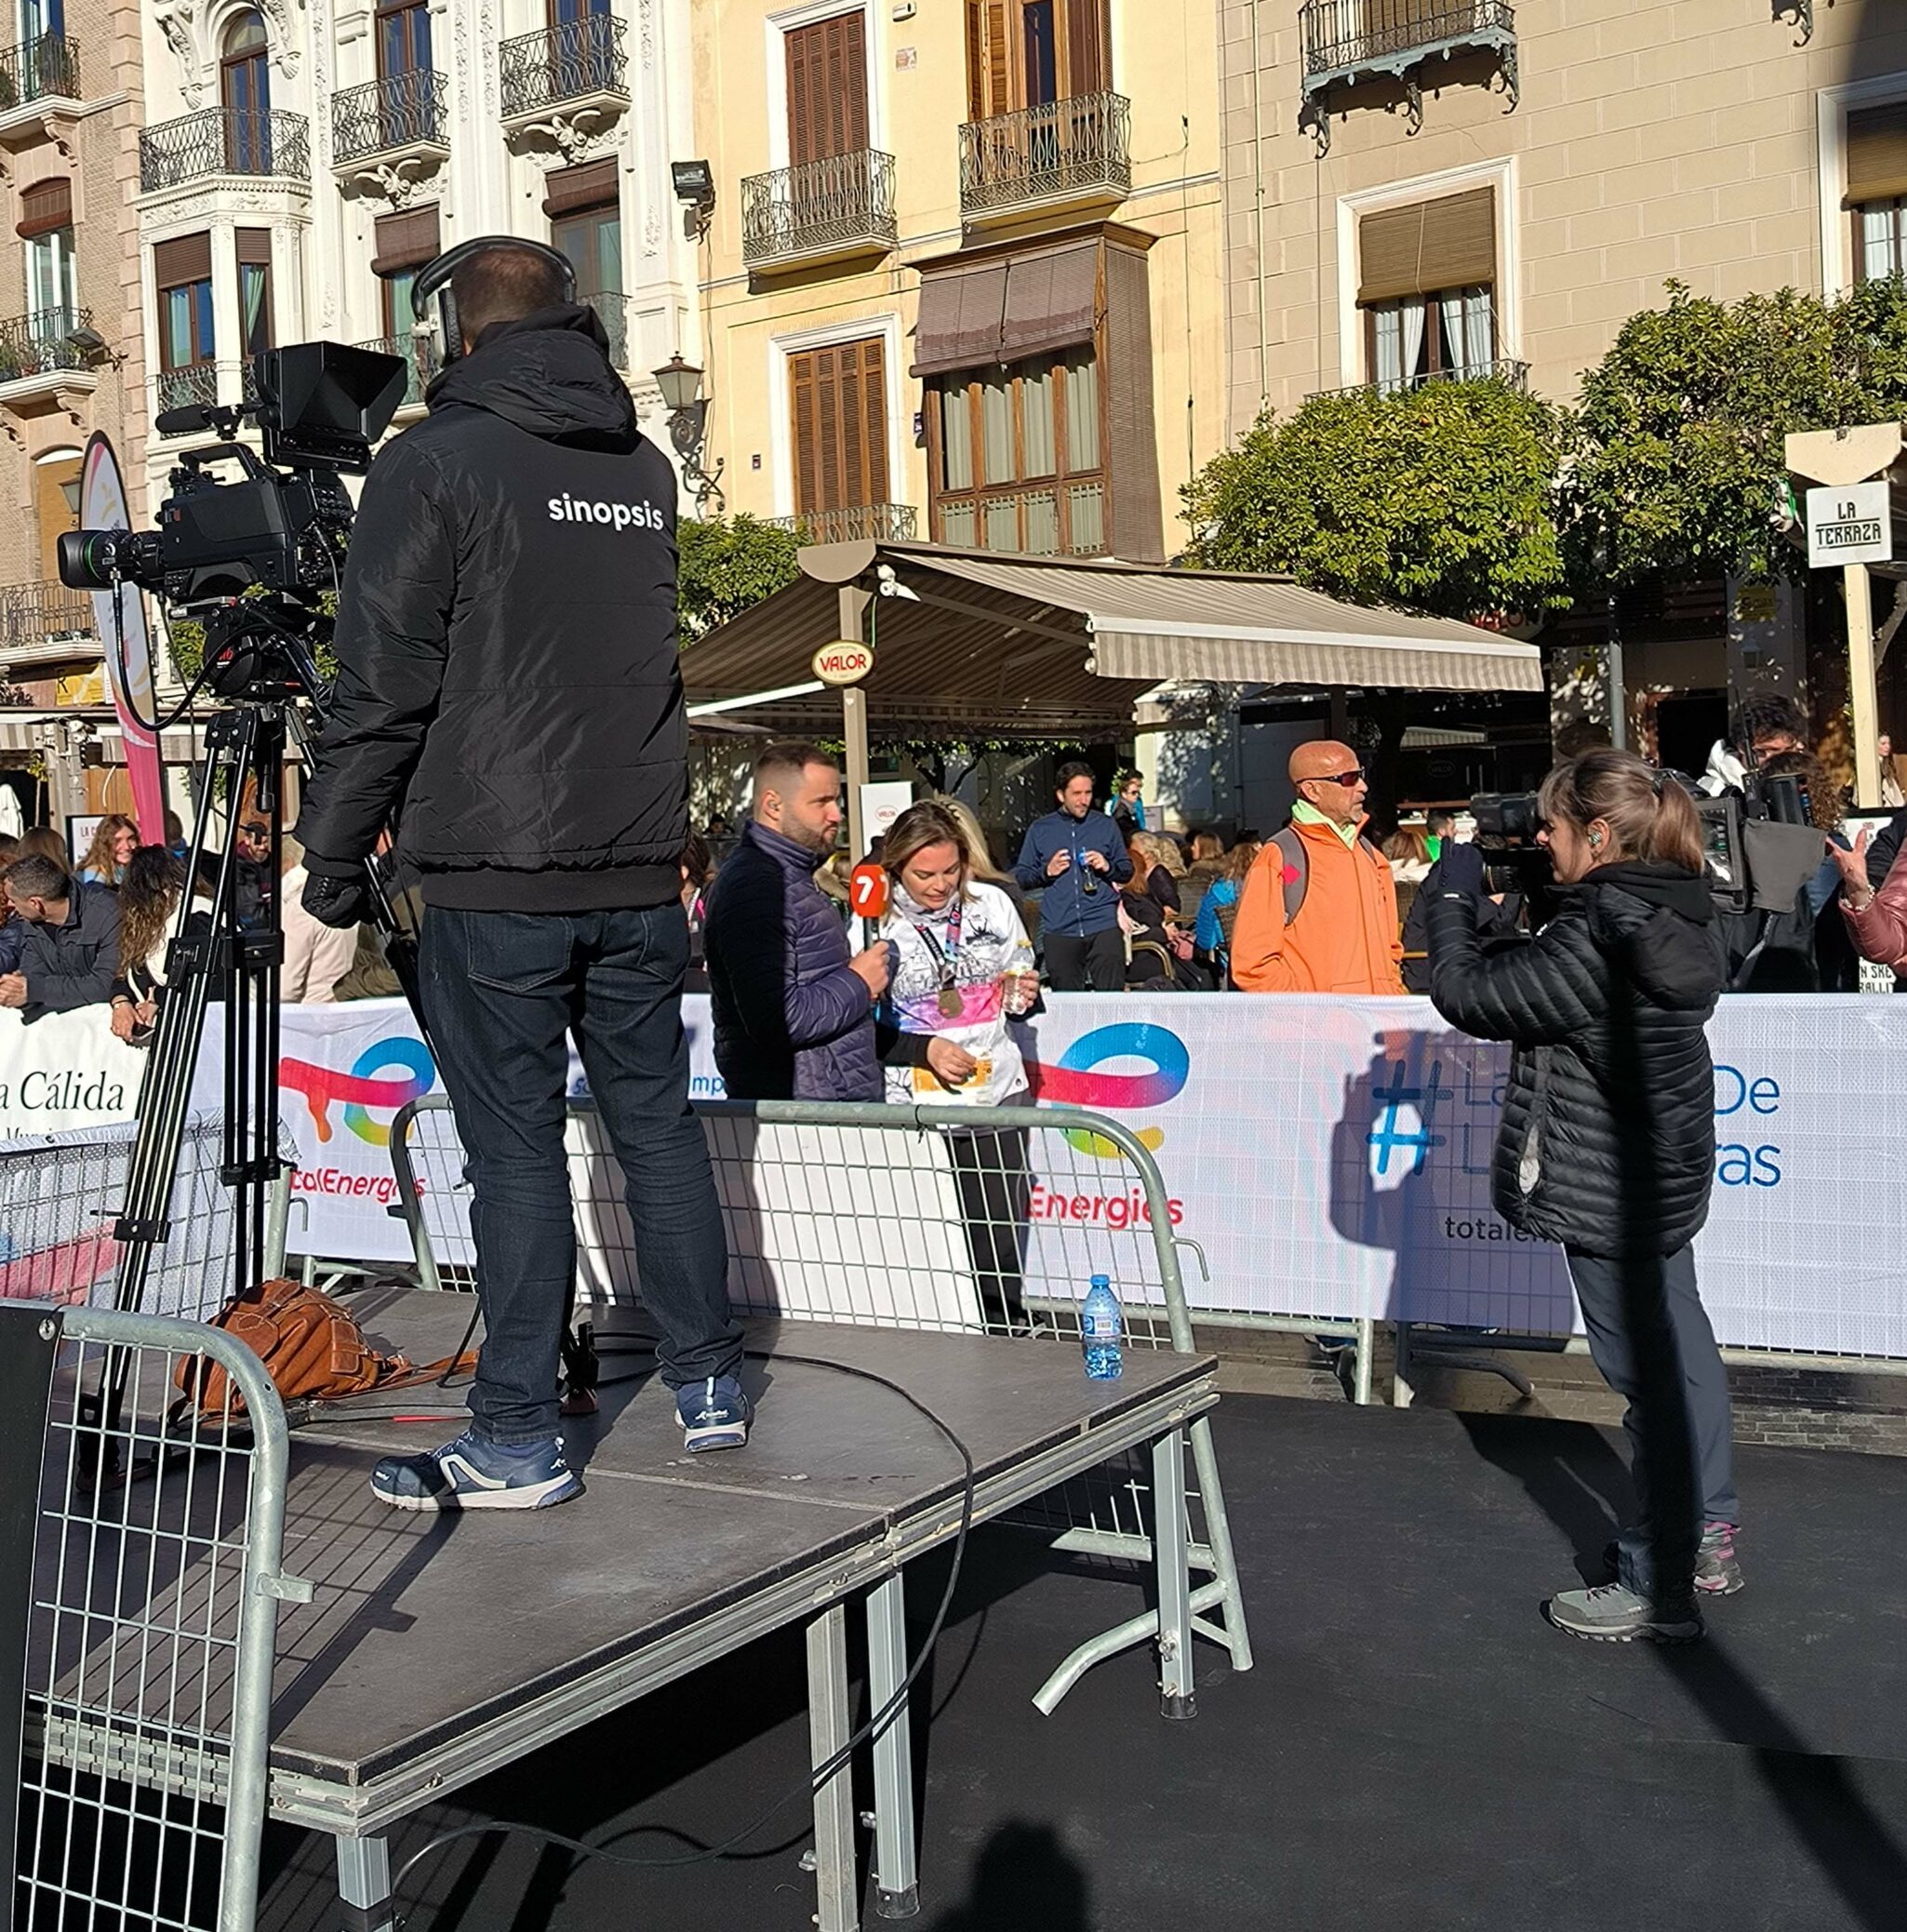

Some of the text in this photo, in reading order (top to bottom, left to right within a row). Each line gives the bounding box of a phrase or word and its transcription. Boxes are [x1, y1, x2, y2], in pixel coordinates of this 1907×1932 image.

[548, 492, 664, 531] sinopsis
[1837, 501, 1856, 520] LA
[1816, 523, 1881, 546] TERRAZA
[820, 653, 867, 672] VALOR
[855, 875, 874, 904] 7
[20, 1071, 125, 1111] Cálida
